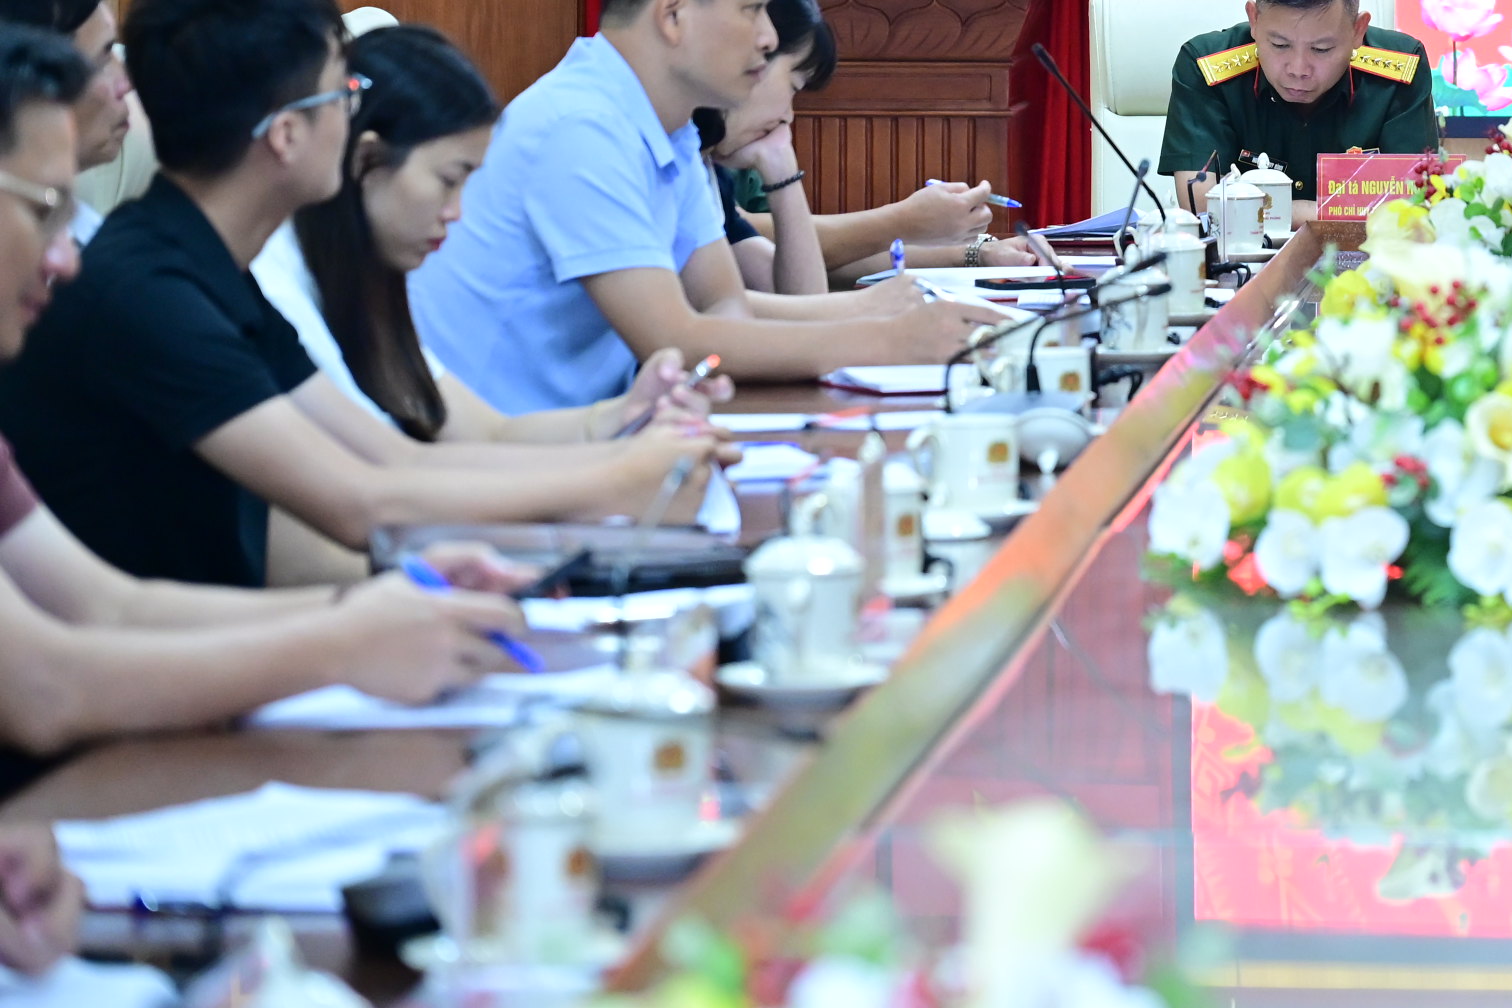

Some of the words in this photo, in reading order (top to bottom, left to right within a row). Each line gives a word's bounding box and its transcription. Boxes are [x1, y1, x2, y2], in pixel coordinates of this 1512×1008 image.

[1328, 180, 1346, 197] Đại
[1348, 180, 1359, 195] tá
[1361, 176, 1404, 195] NGUYỄN
